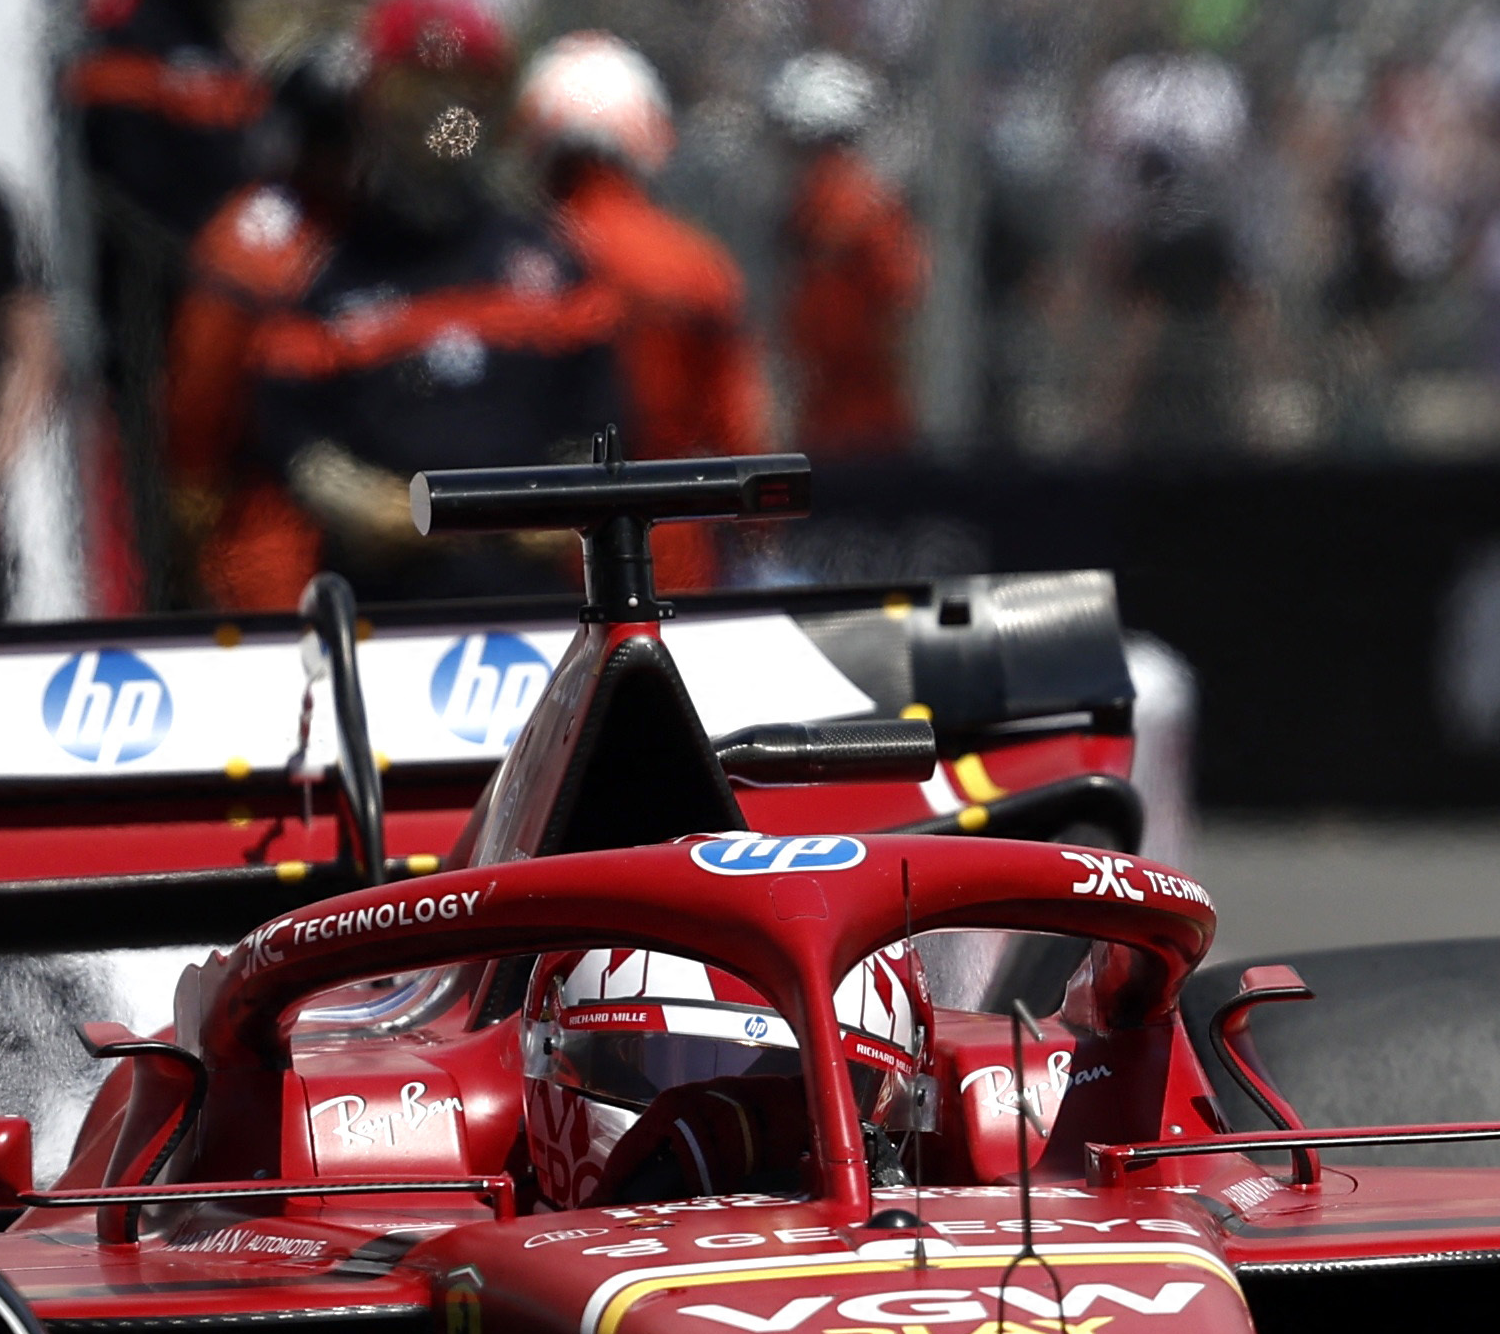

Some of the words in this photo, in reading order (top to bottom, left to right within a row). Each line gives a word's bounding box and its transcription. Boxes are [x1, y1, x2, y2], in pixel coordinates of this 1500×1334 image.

[50, 650, 164, 764] hp
[441, 633, 548, 746] hp
[293, 890, 481, 945] TECHNOLOGY
[569, 1012, 609, 1025] RICHARD
[612, 1011, 647, 1024] MILLE
[745, 1016, 768, 1038] hp
[856, 1043, 895, 1066] RICHARD
[695, 1217, 1201, 1250] GEESYS
[677, 1281, 1206, 1333] VGW
